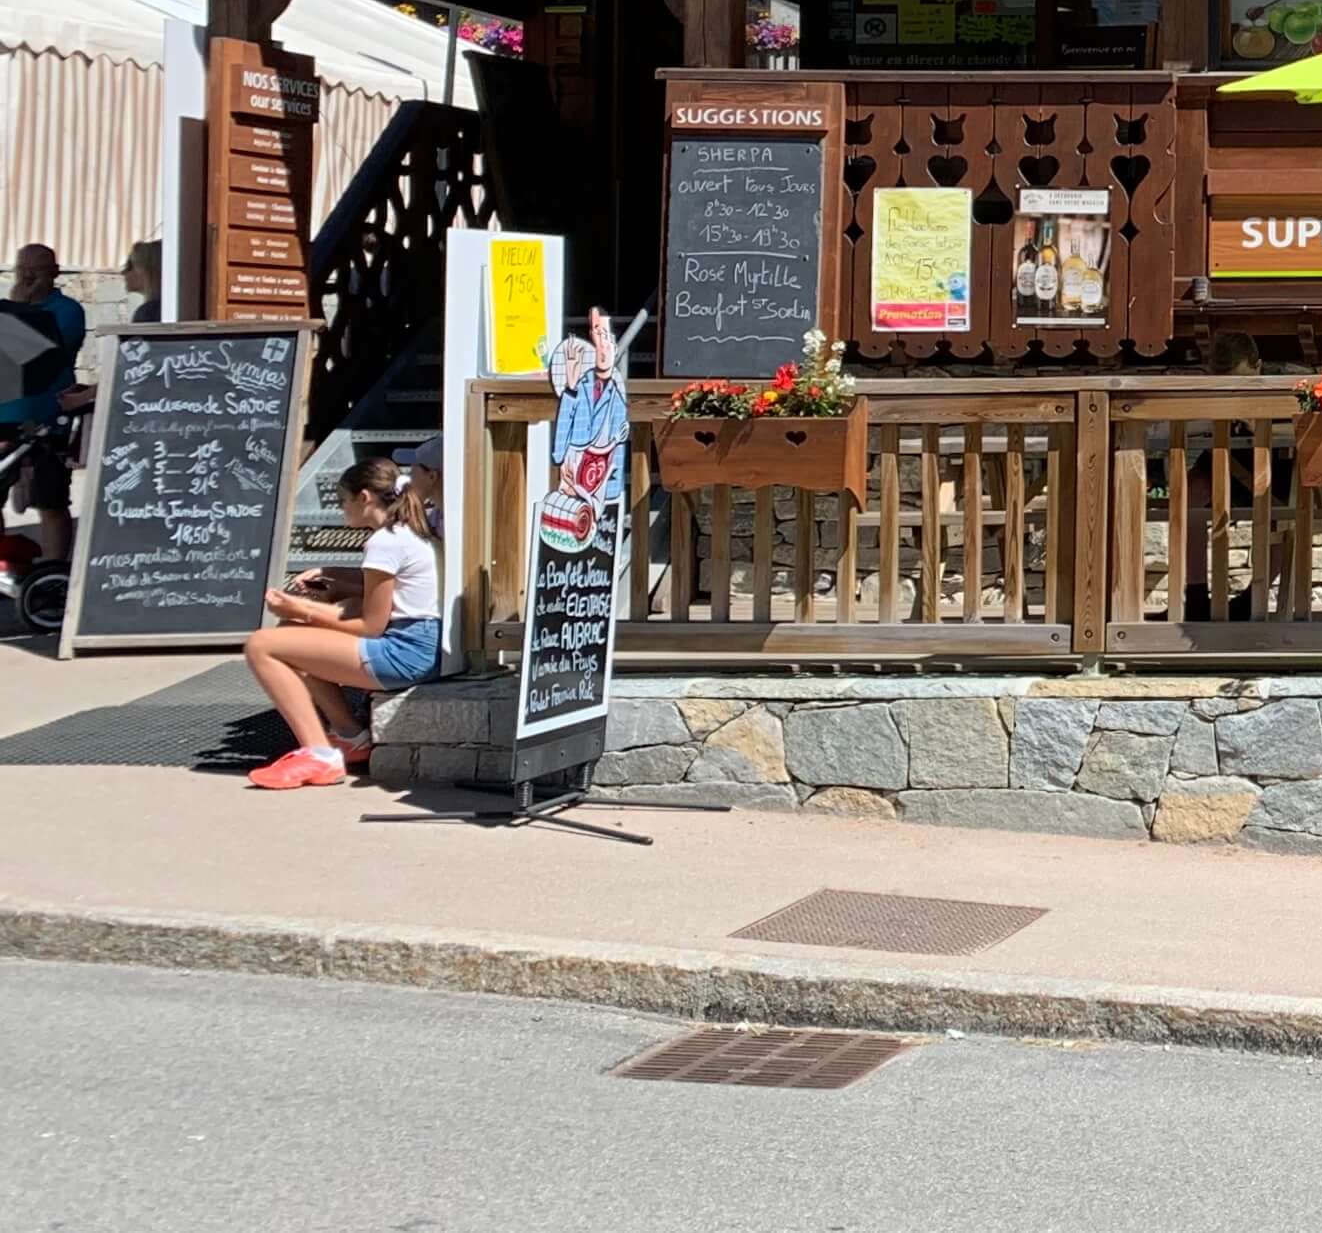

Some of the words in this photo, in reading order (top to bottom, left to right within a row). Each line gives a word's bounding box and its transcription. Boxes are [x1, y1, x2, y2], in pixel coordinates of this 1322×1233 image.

[242, 70, 269, 90] NOS
[269, 74, 321, 99] SERVICES
[250, 94, 270, 109] our
[271, 97, 313, 115] services
[675, 107, 824, 127] SUGGESTIONS
[698, 146, 774, 164] SHERPA
[677, 174, 733, 195] ouvert
[744, 176, 776, 195] tous
[501, 246, 538, 267] MELON
[683, 257, 727, 284] Rosé
[156, 344, 214, 390] prix
[560, 620, 606, 651] AUBRAC
[572, 650, 599, 680] Pays
